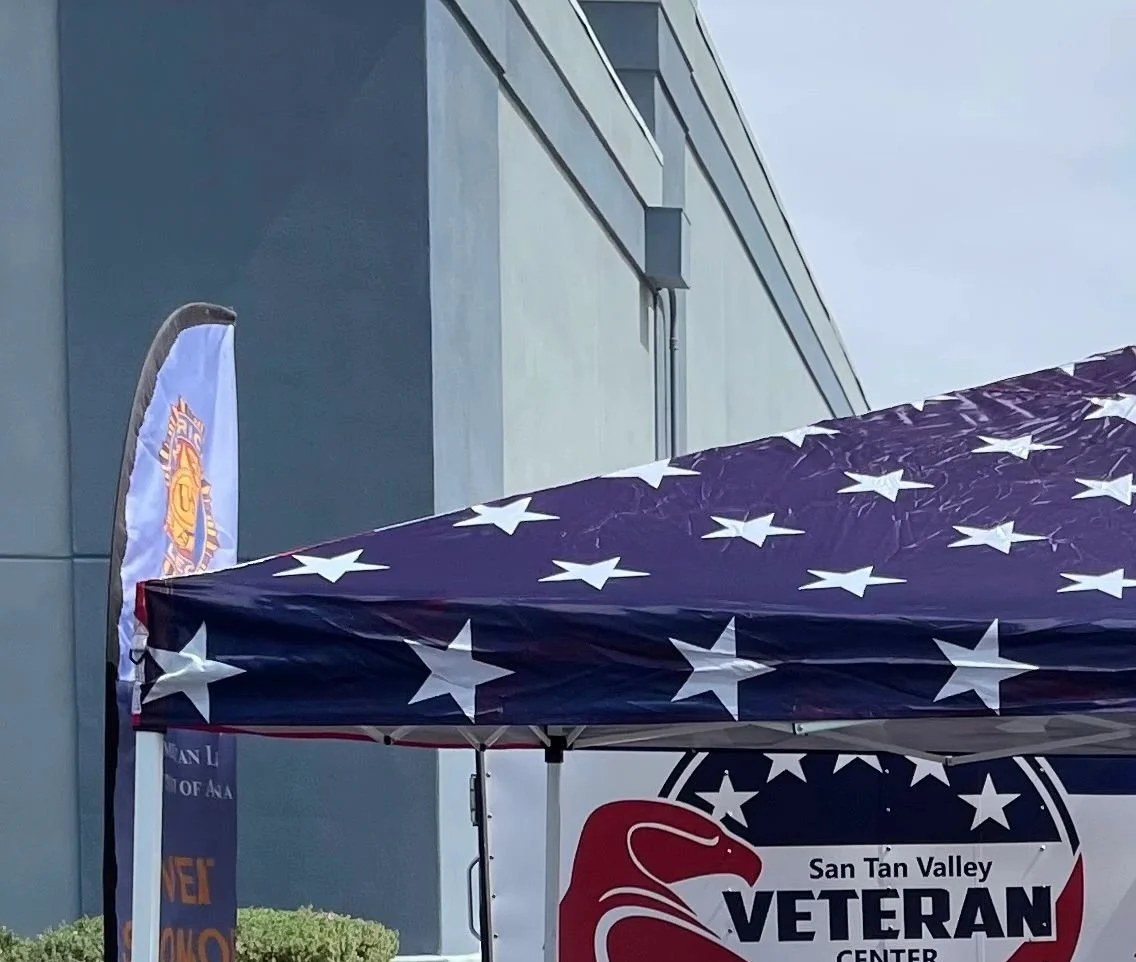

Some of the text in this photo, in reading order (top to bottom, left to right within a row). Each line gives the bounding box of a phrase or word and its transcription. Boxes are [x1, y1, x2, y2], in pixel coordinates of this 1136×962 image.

[808, 855, 993, 883] San Tan Valley
[721, 885, 1052, 942] VETERAN
